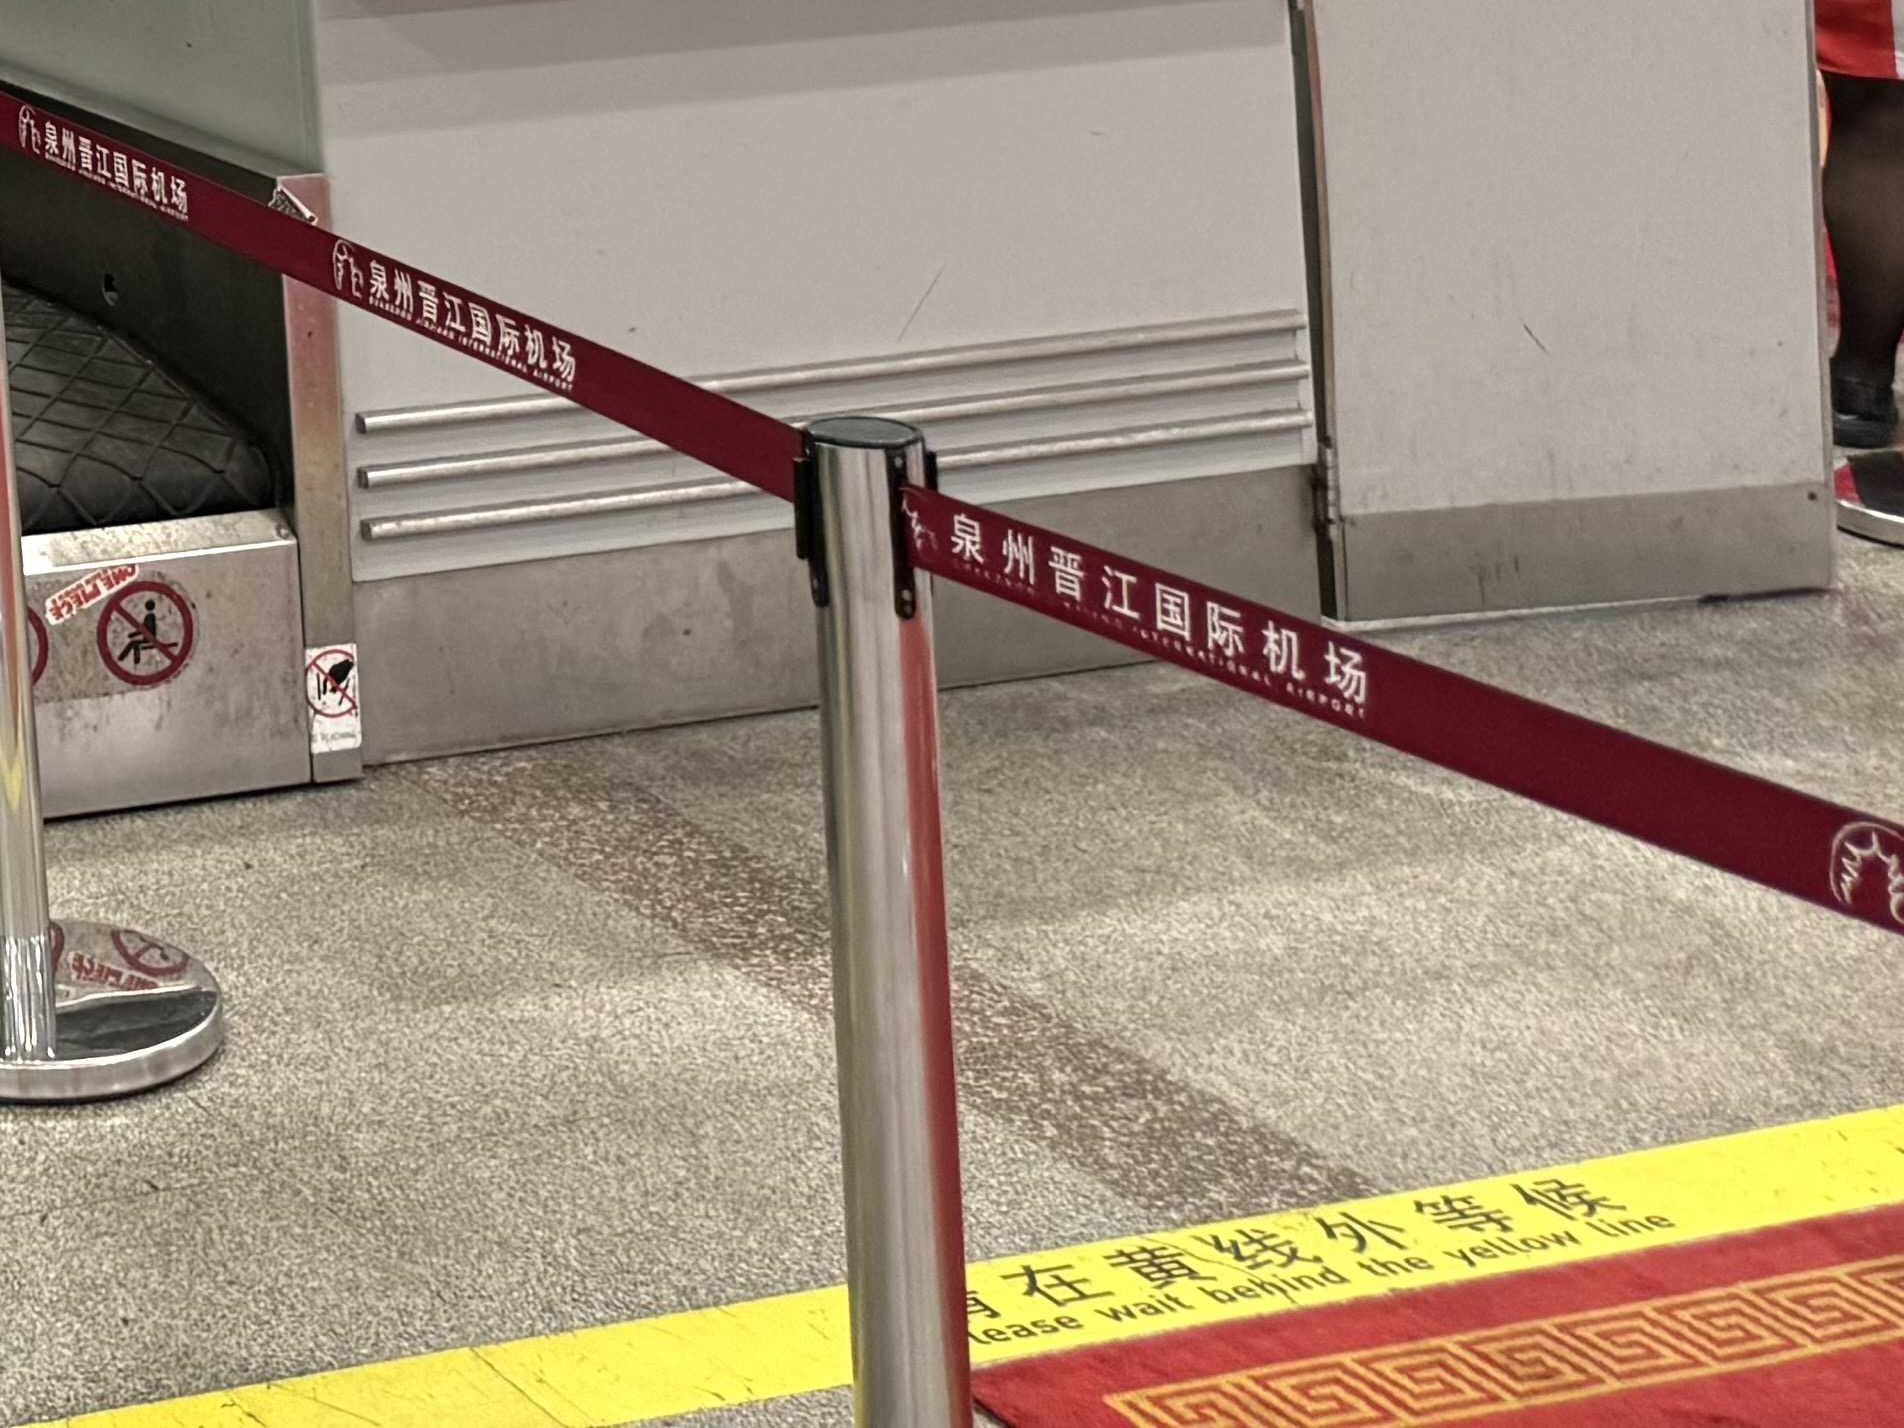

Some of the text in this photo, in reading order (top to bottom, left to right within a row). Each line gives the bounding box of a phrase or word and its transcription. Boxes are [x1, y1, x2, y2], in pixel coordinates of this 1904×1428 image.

[43, 119, 189, 216] 泉州晋江国际机场
[368, 258, 576, 385] 泉州晋江国际机场
[950, 513, 1369, 706] 泉州晋江国际机场
[968, 1210, 1677, 1346] lease wait behind the yellow line
